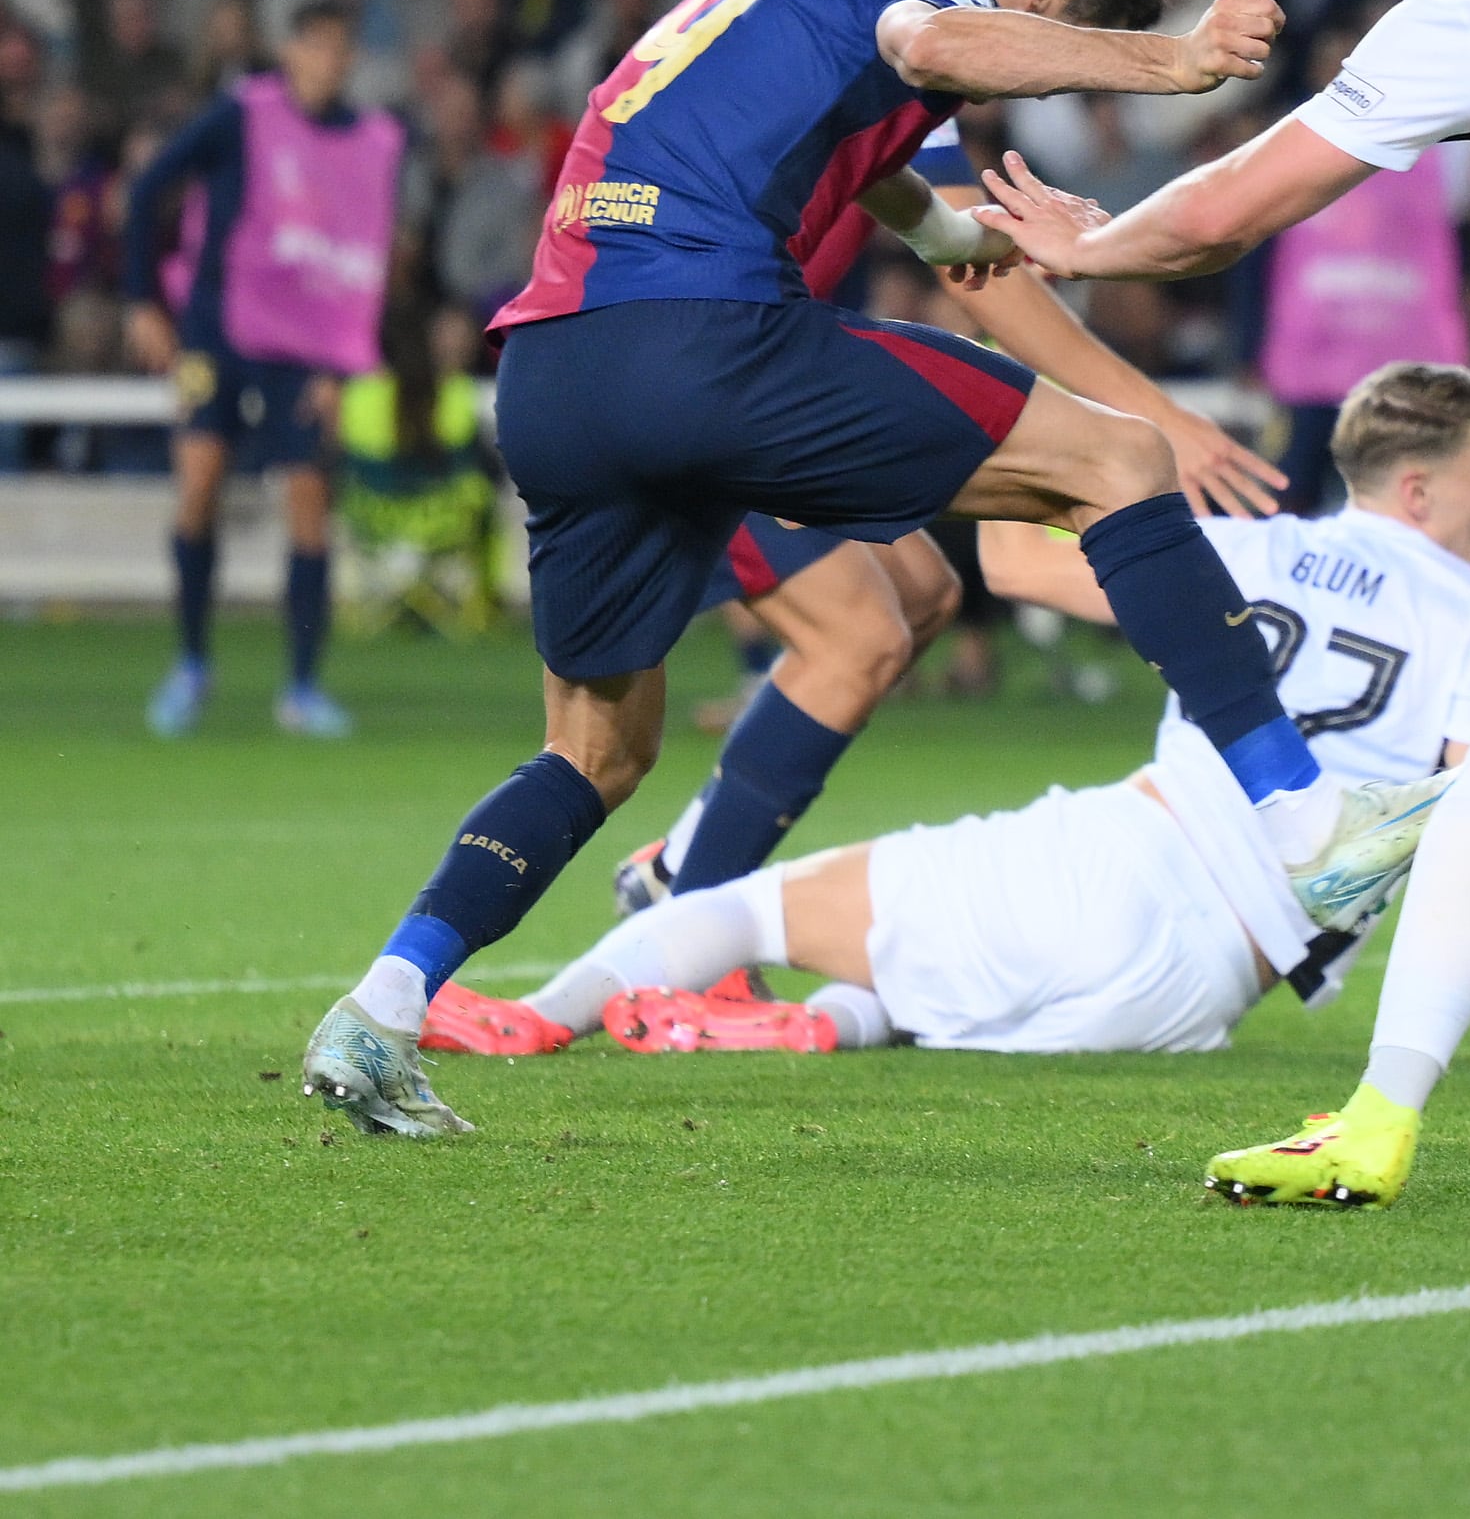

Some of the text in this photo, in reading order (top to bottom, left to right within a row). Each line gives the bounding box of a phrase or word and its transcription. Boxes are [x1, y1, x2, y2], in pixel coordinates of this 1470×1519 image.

[584, 182, 660, 206] UNHCR
[580, 200, 656, 226] ACNUR
[1290, 551, 1386, 606] BLUM
